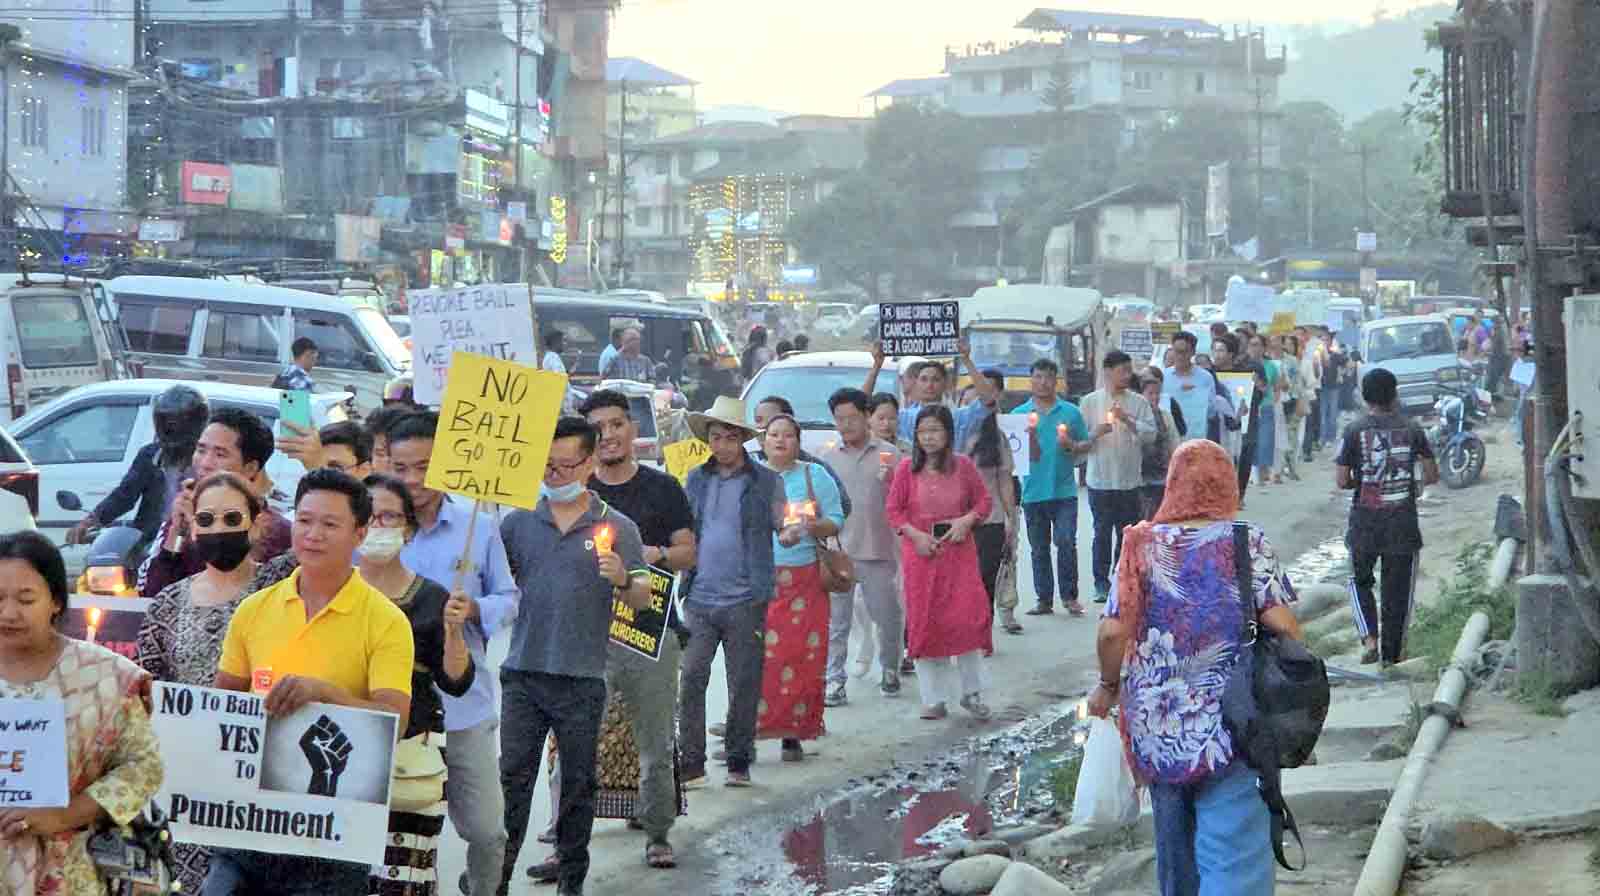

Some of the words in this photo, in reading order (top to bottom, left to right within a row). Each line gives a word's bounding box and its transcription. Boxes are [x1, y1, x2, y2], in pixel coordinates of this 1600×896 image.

[412, 292, 470, 314] REVOKE
[472, 289, 515, 311] BAIL
[883, 322, 914, 337] CANCEL
[915, 321, 934, 337] BAIL
[934, 321, 956, 336] PLEA
[421, 344, 449, 366] WE
[882, 339, 893, 353] BE
[895, 340, 900, 353] A
[901, 339, 924, 353] GOOD
[925, 338, 959, 353] LAWYER
[479, 366, 529, 406] NO
[448, 399, 531, 445] BAIL
[453, 437, 485, 465] GO
[496, 447, 521, 470] TO
[442, 469, 513, 497] JAIL
[160, 687, 193, 717] NO
[200, 691, 221, 712] To
[225, 695, 264, 719] Bail,
[15, 718, 50, 732] WANT
[219, 723, 261, 754] YES
[235, 760, 256, 780] To
[167, 793, 342, 842] Punishment.
